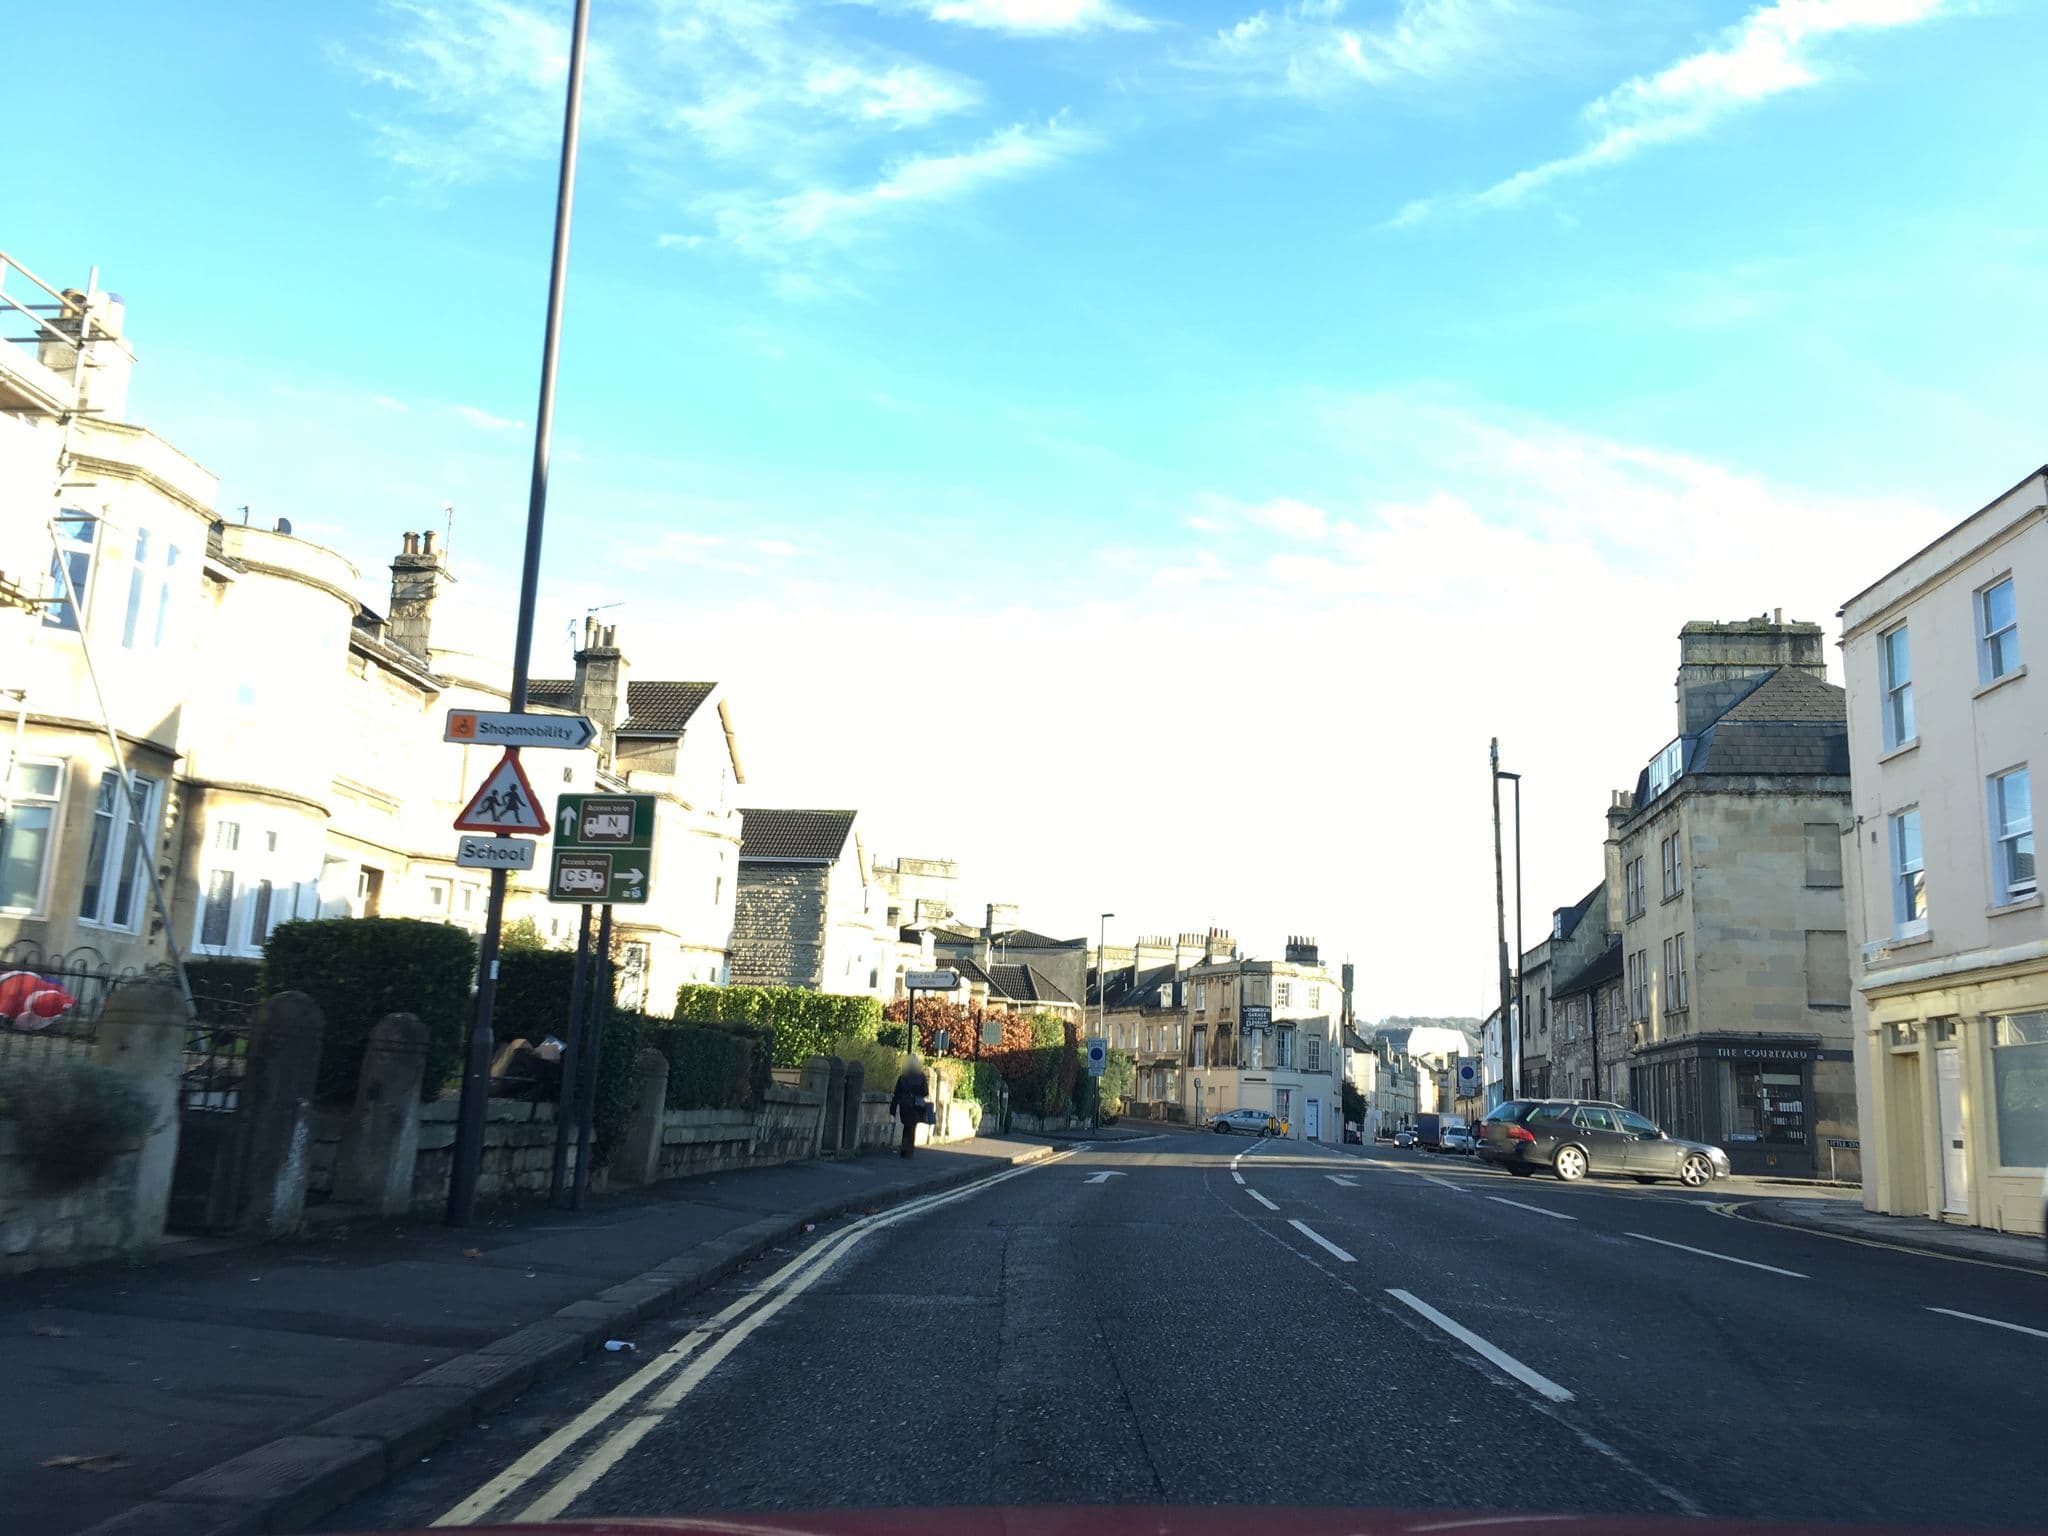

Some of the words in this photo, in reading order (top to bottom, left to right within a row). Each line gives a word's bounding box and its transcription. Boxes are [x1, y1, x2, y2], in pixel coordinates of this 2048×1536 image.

[479, 721, 573, 740] Shopmobility
[586, 804, 611, 812] Access
[608, 816, 619, 828] N
[463, 844, 525, 861] School
[561, 858, 586, 866] Access
[566, 870, 576, 882] C
[579, 870, 588, 882] S
[1718, 1048, 1737, 1057] THE
[1744, 1048, 1808, 1059] COURTYARD
